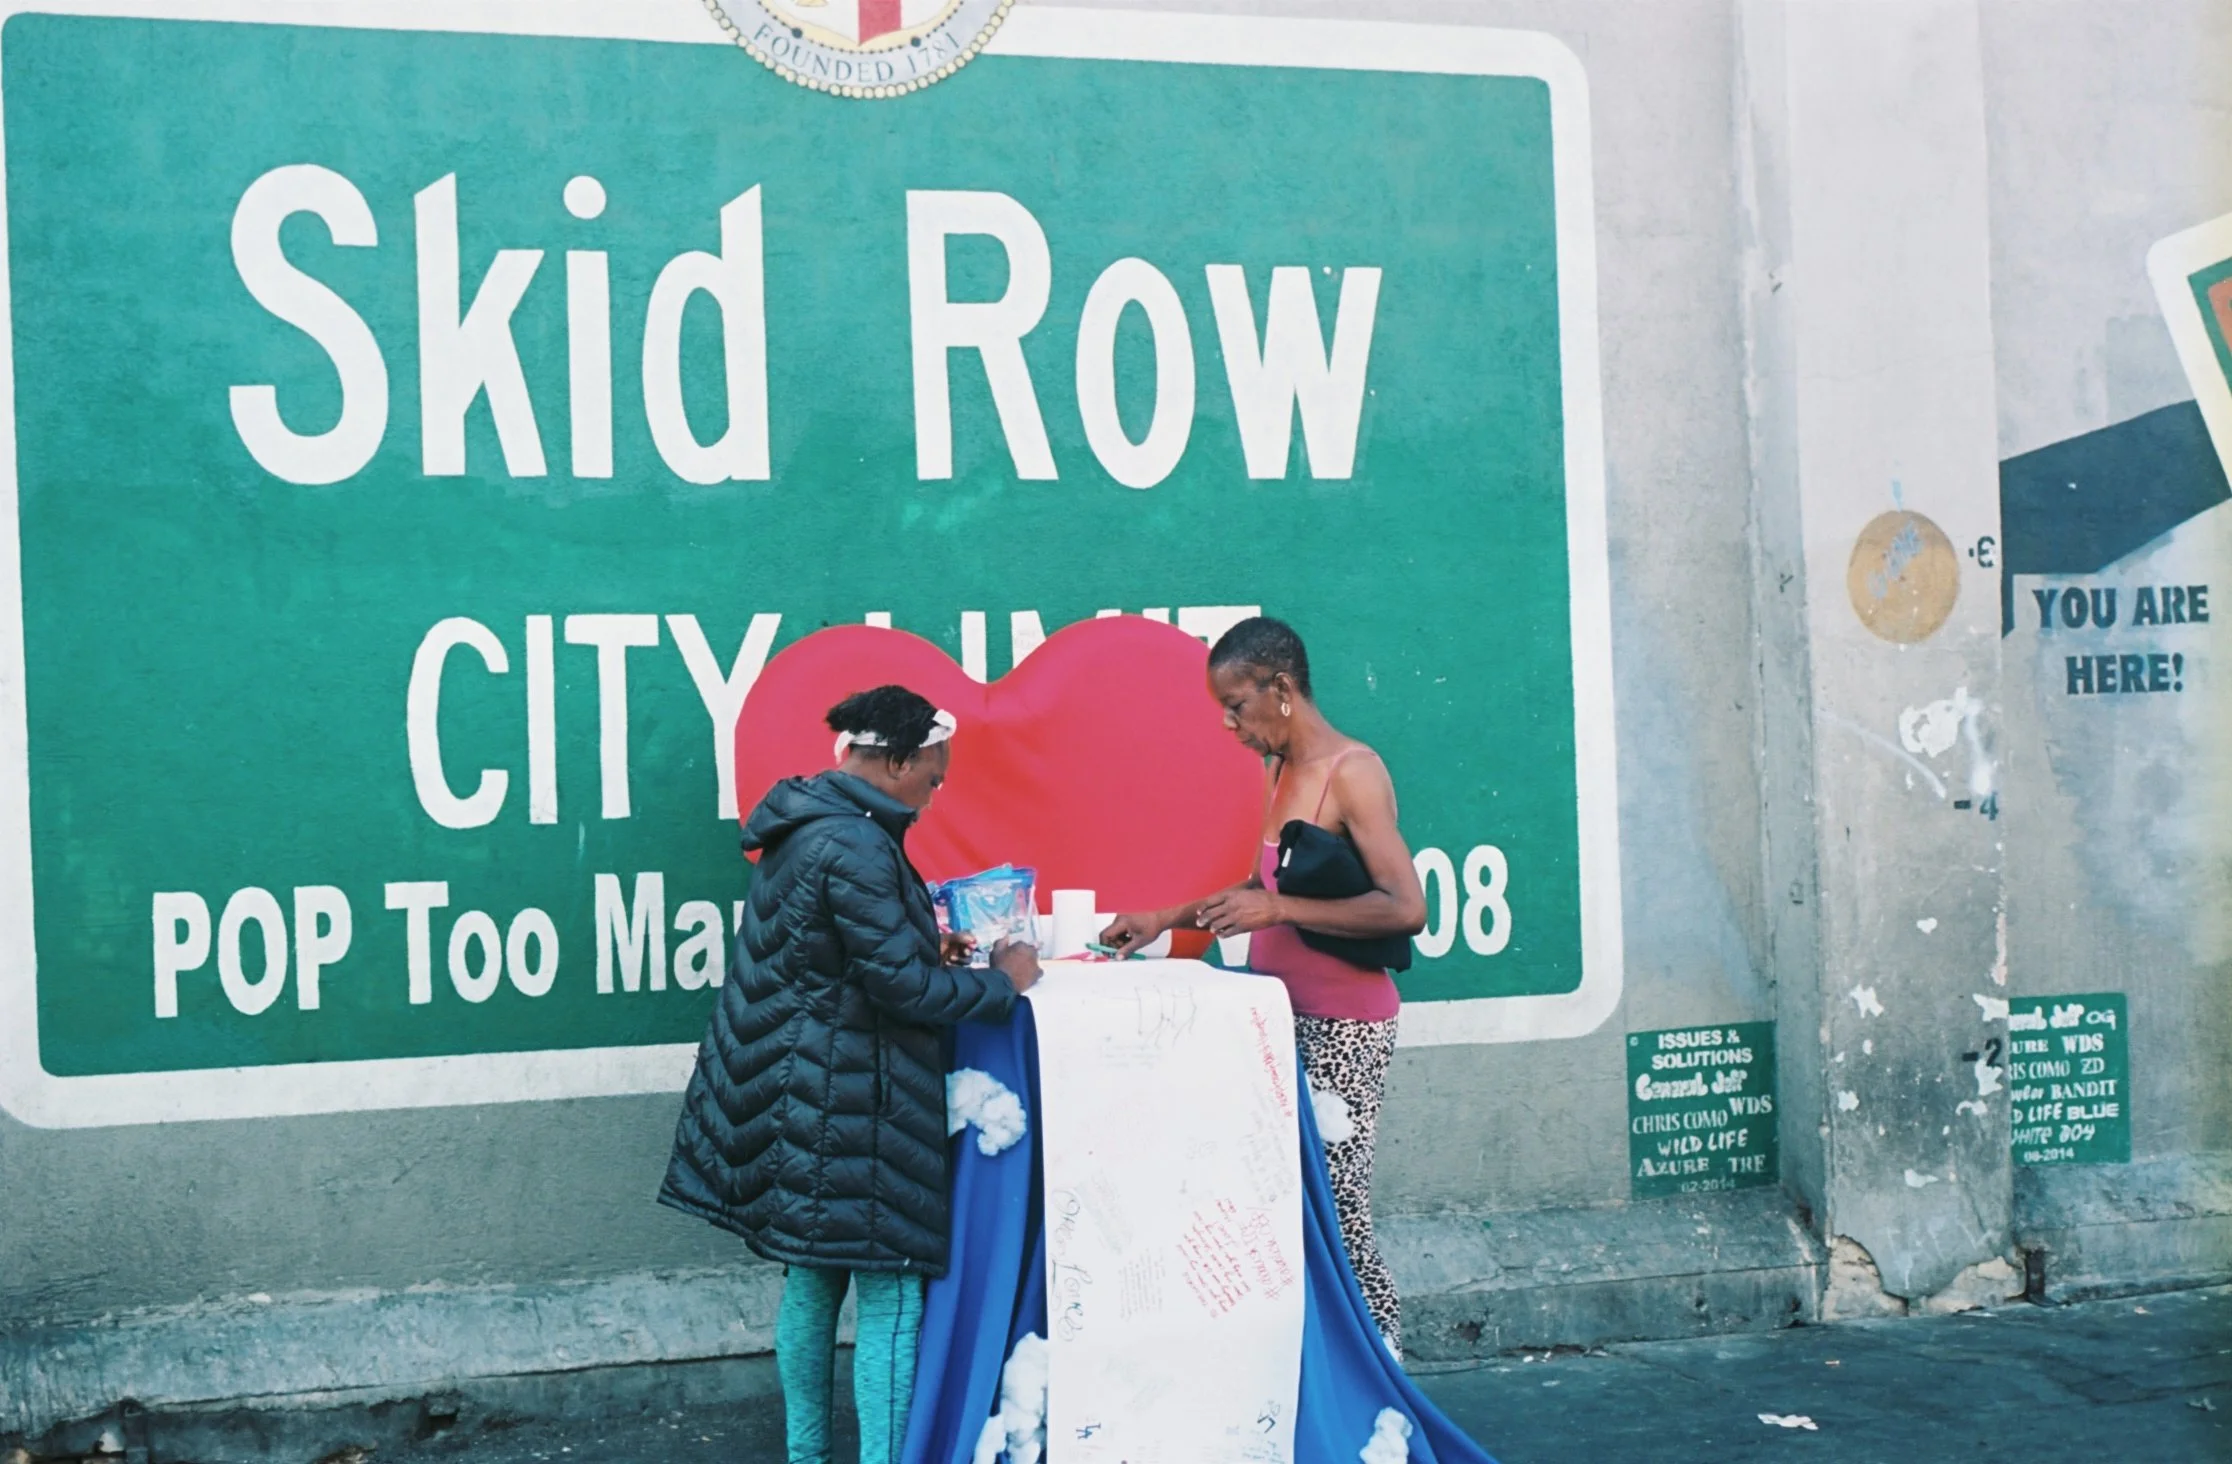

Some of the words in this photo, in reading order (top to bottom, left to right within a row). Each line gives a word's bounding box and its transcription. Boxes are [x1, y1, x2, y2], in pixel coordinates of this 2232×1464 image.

[753, 22, 894, 83] FOUNDED
[907, 31, 960, 74] 1781
[229, 163, 772, 486] Skid
[905, 188, 1383, 489] Row
[2032, 586, 2117, 629] YOU
[2132, 585, 2210, 627] ARE
[2065, 652, 2184, 695] HERE!
[407, 612, 782, 829] CITY
[152, 885, 353, 1019] POP
[384, 881, 560, 1004] Too
[594, 871, 746, 994] Ma
[1658, 1029, 1722, 1050] ISSUES
[1726, 1029, 1740, 1044] &
[2010, 1040, 2050, 1054] URE
[2061, 1032, 2105, 1055] WDS
[1651, 1048, 1754, 1070] SOLUTIONS
[2029, 1060, 2071, 1080] COMO
[2051, 1079, 2119, 1101] BANDIT
[1728, 1094, 1773, 1117] WDS
[2028, 1102, 2064, 1123] LIFE
[2067, 1103, 2121, 1121] BLUE
[1632, 1112, 1681, 1135] CHRIS
[1683, 1109, 1729, 1130] COMO
[1657, 1135, 1704, 1157] WILD
[1708, 1128, 1749, 1151] LIFE
[1637, 1156, 1710, 1177] AZURE
